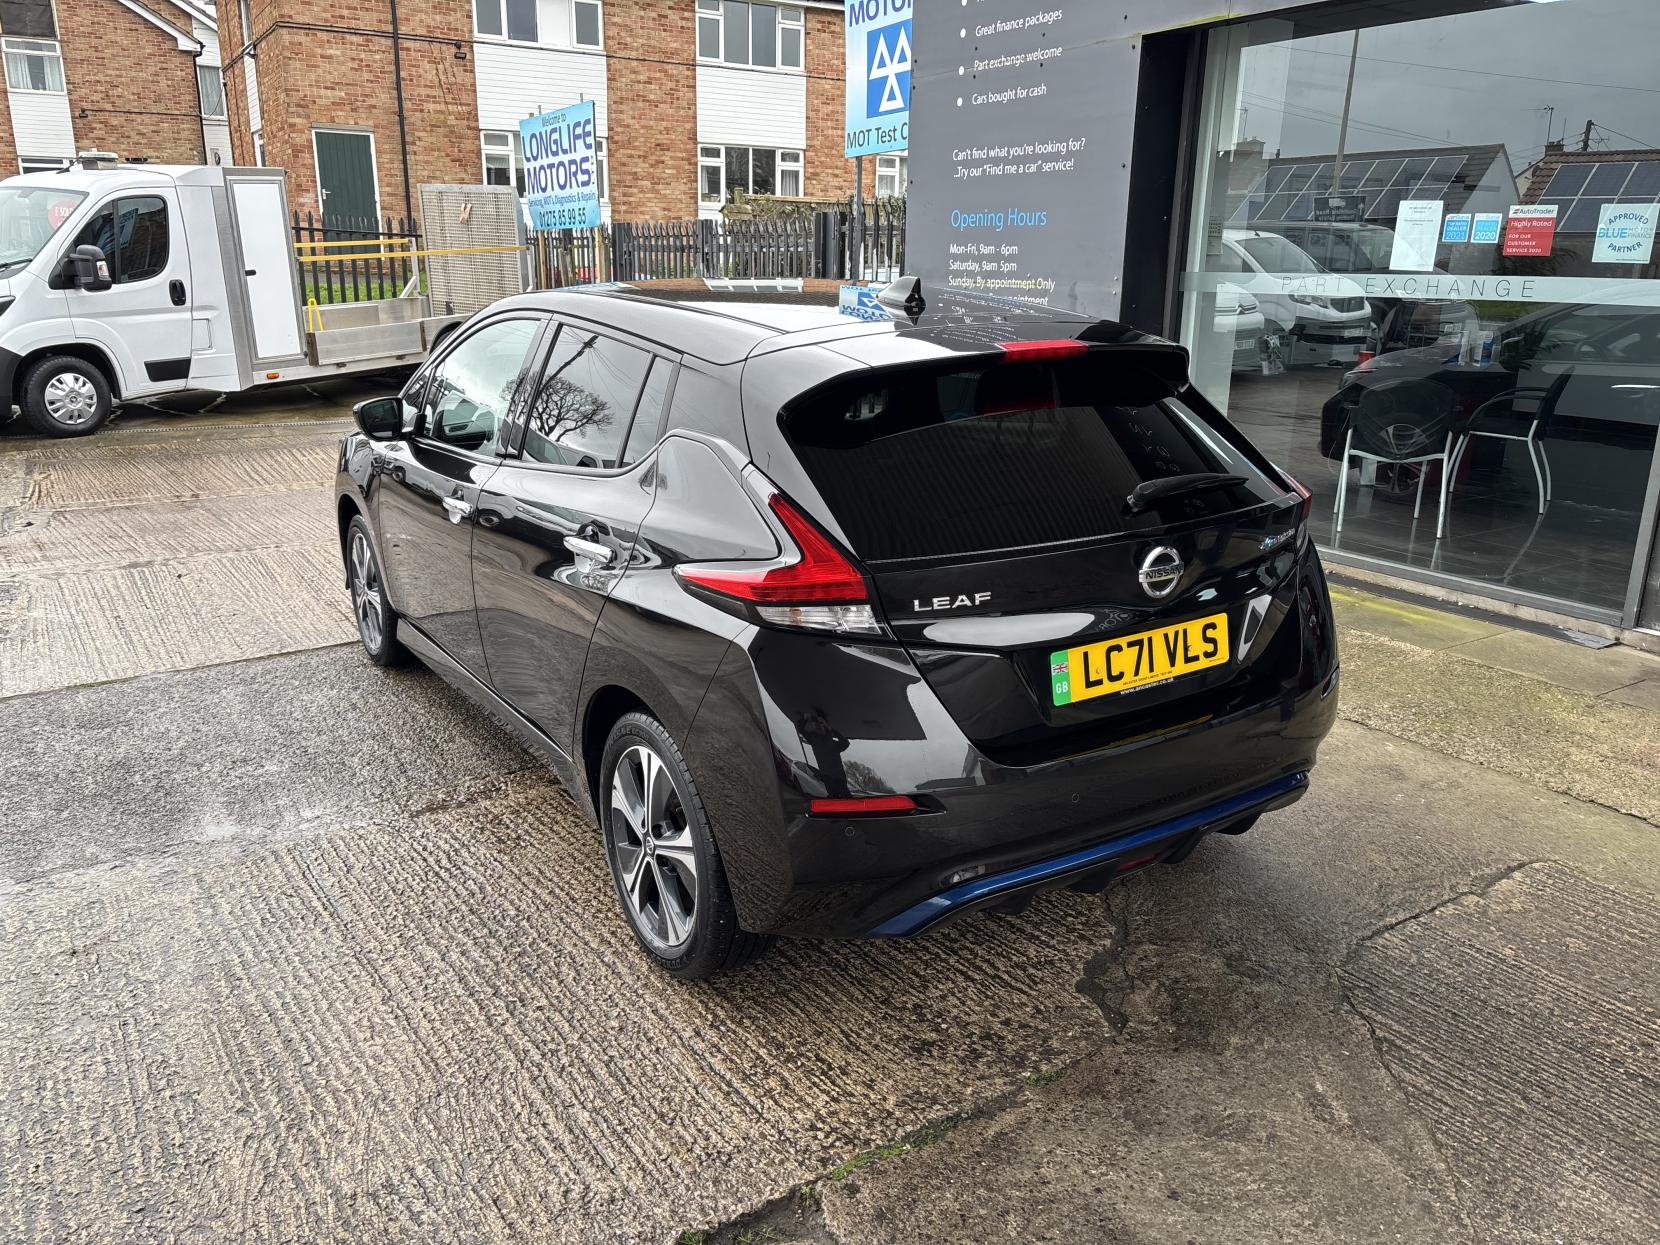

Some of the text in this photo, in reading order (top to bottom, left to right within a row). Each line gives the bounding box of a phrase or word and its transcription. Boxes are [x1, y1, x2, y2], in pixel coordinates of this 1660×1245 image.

[975, 9, 1062, 36] Great finance packages
[974, 46, 1062, 71] Part exchange welcome
[972, 83, 1046, 105] Cars bought for cash
[542, 112, 567, 128] Welcome to
[522, 118, 592, 163] LONGLIFE
[846, 128, 872, 149] MOT
[874, 125, 897, 144] Test
[952, 137, 1086, 160] Can't find what you're looking for?
[527, 156, 592, 195] MOTORS
[970, 166, 982, 177] our
[1004, 164, 1017, 174] me
[1018, 164, 1024, 173] a
[1042, 158, 1074, 172] service!
[581, 191, 596, 202] Repairs
[539, 207, 587, 228] 01275 85 99 55
[951, 208, 1047, 231] Opening Hours
[1510, 220, 1531, 228] Highly
[1608, 212, 1648, 225] APPROVED
[1597, 227, 1628, 238] BLUE
[950, 244, 978, 256] Mon-Fri,
[979, 244, 995, 254] 9am
[1001, 244, 1018, 256] 6pm
[1608, 242, 1643, 253] PARTNER
[949, 259, 1017, 273] Saturday, 9am 5pm
[948, 276, 1056, 292] Sunday, By appointment Only
[1281, 276, 1536, 298] PART EXCHANGE
[1146, 567, 1180, 579] NISSAN
[913, 591, 991, 611] LEAF
[1083, 636, 1154, 689] LC71
[1164, 622, 1218, 668] VLS
[1055, 681, 1069, 694] GB
